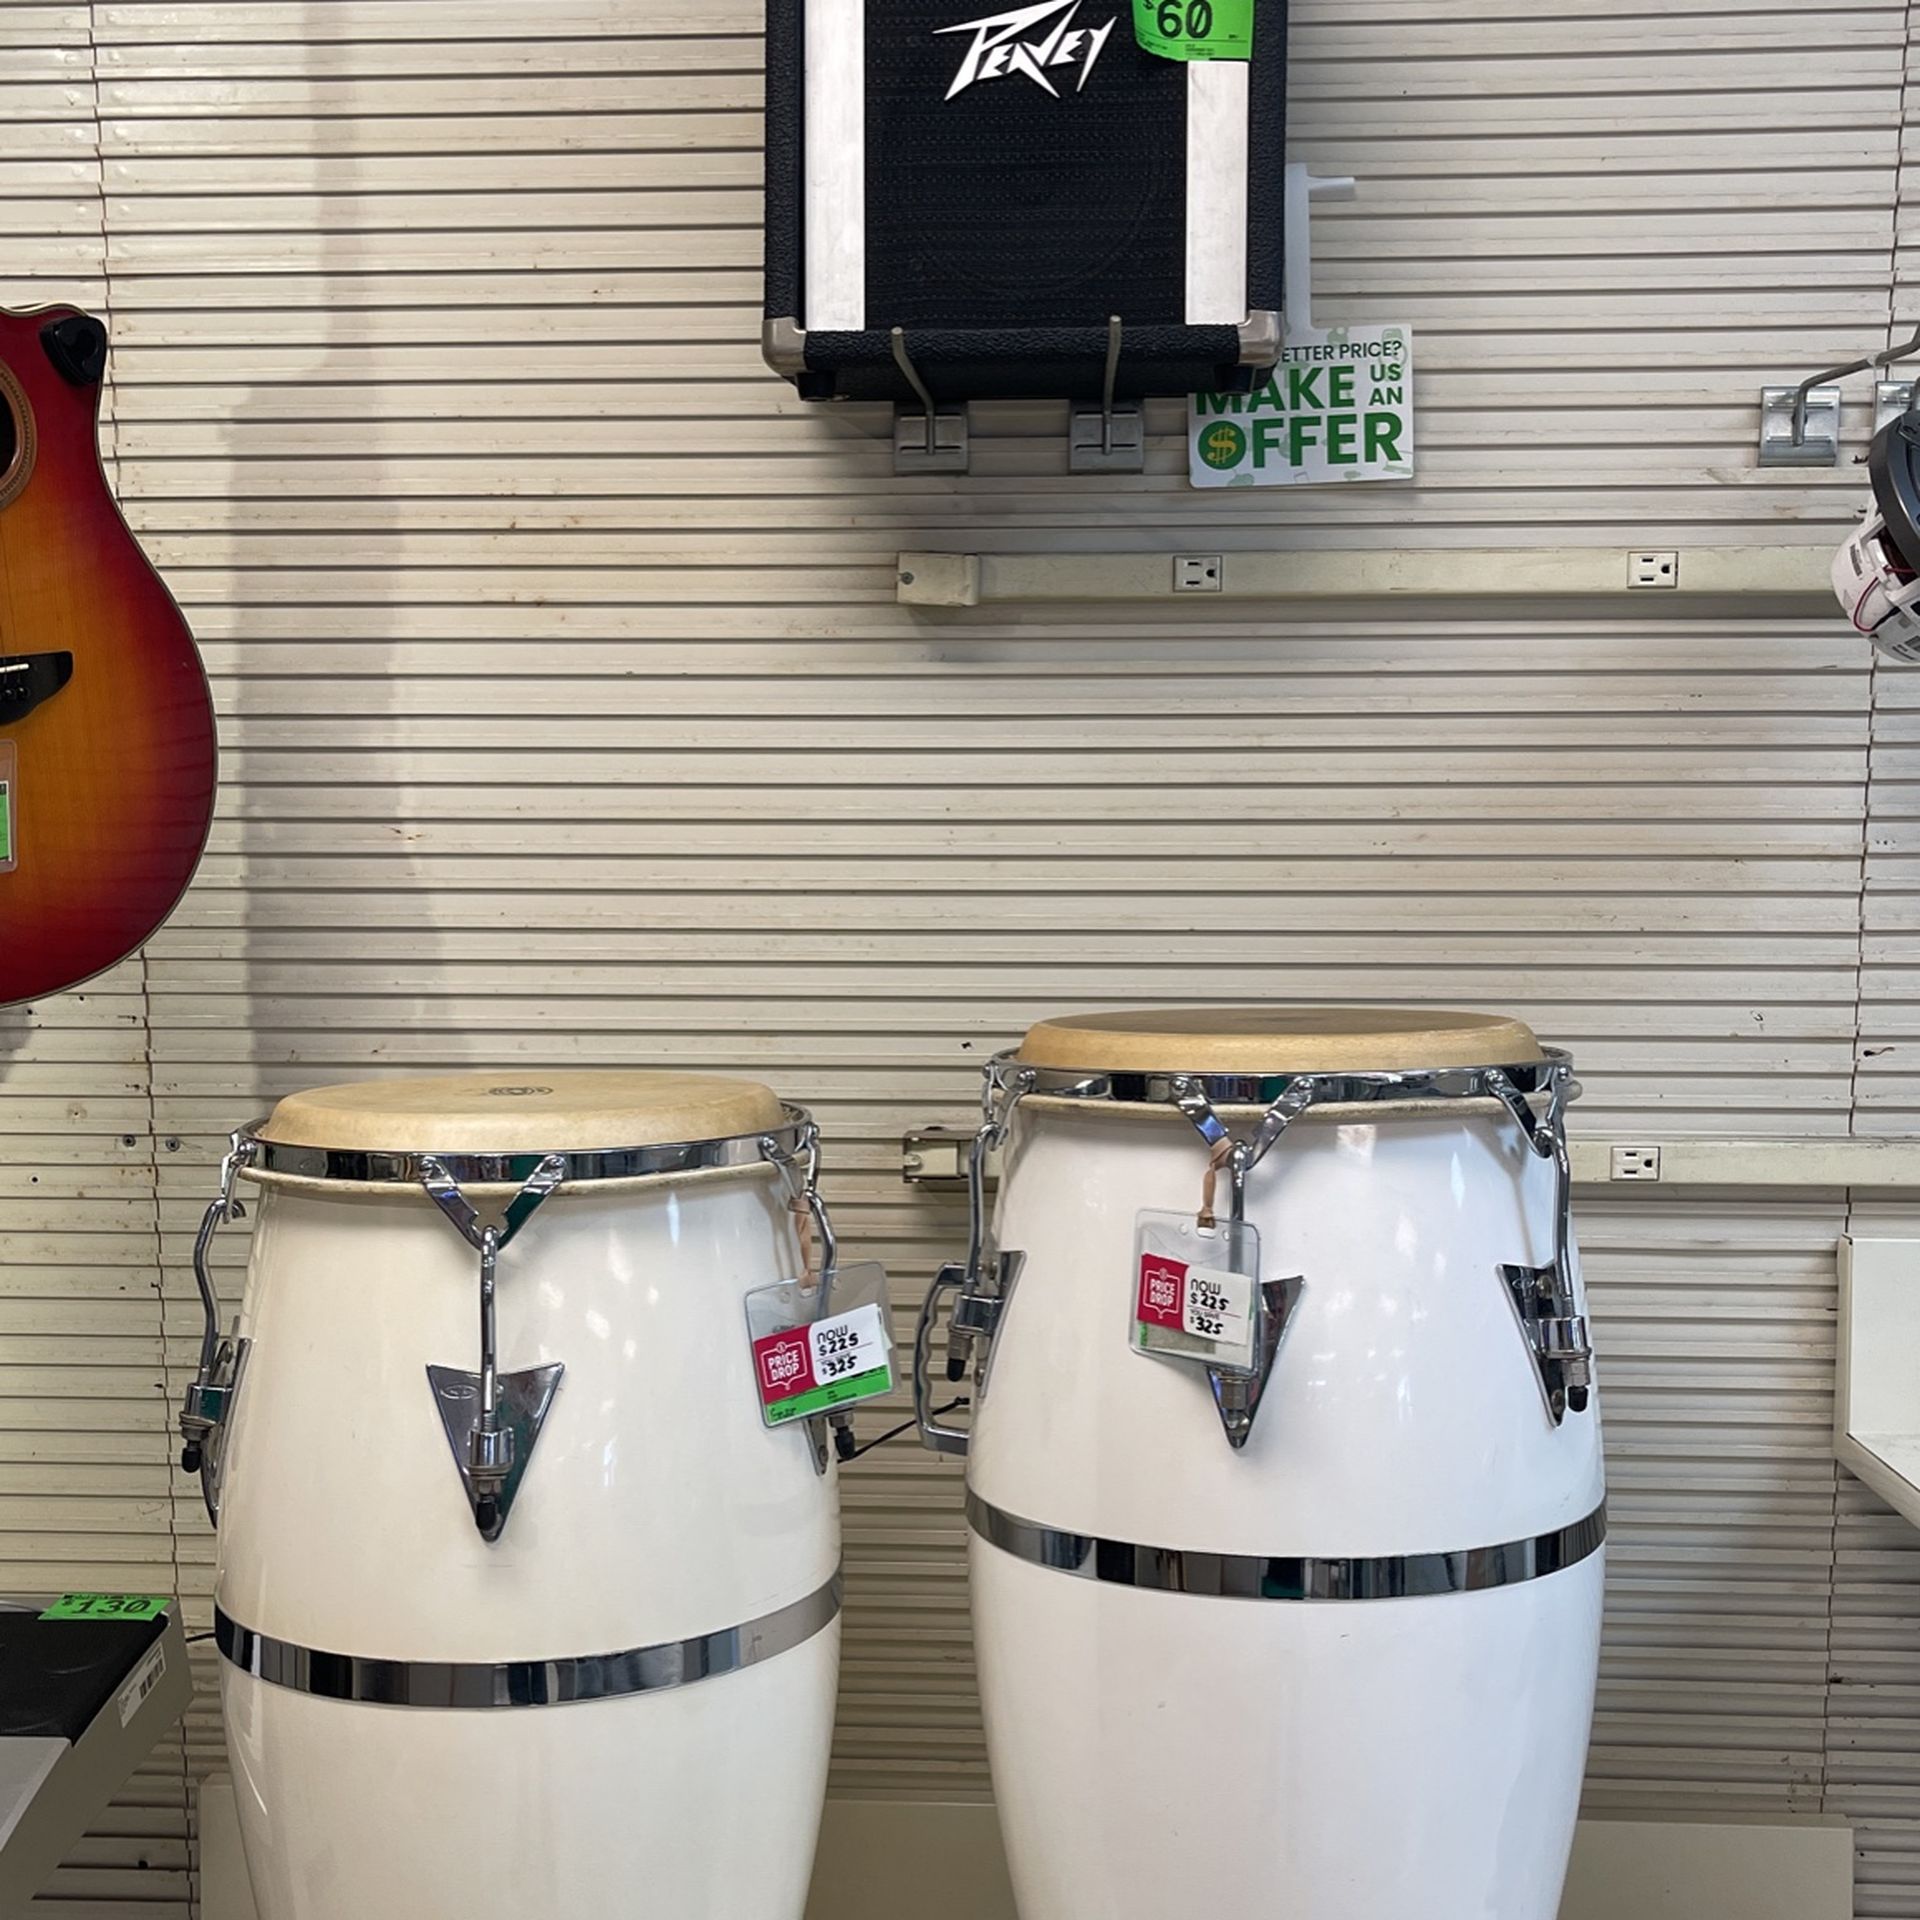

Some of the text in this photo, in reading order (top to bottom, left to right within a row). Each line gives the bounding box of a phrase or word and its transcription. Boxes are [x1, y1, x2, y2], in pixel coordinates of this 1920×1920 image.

[932, 0, 1117, 101] PEAVEY
[1281, 340, 1402, 363] ETTER PRICE?
[1370, 363, 1401, 382] US
[1368, 386, 1403, 406] AN
[1149, 1279, 1175, 1296] PRICE
[1149, 1291, 1174, 1307] DROP
[768, 1350, 799, 1370] PRICE
[771, 1363, 799, 1381] DROP
